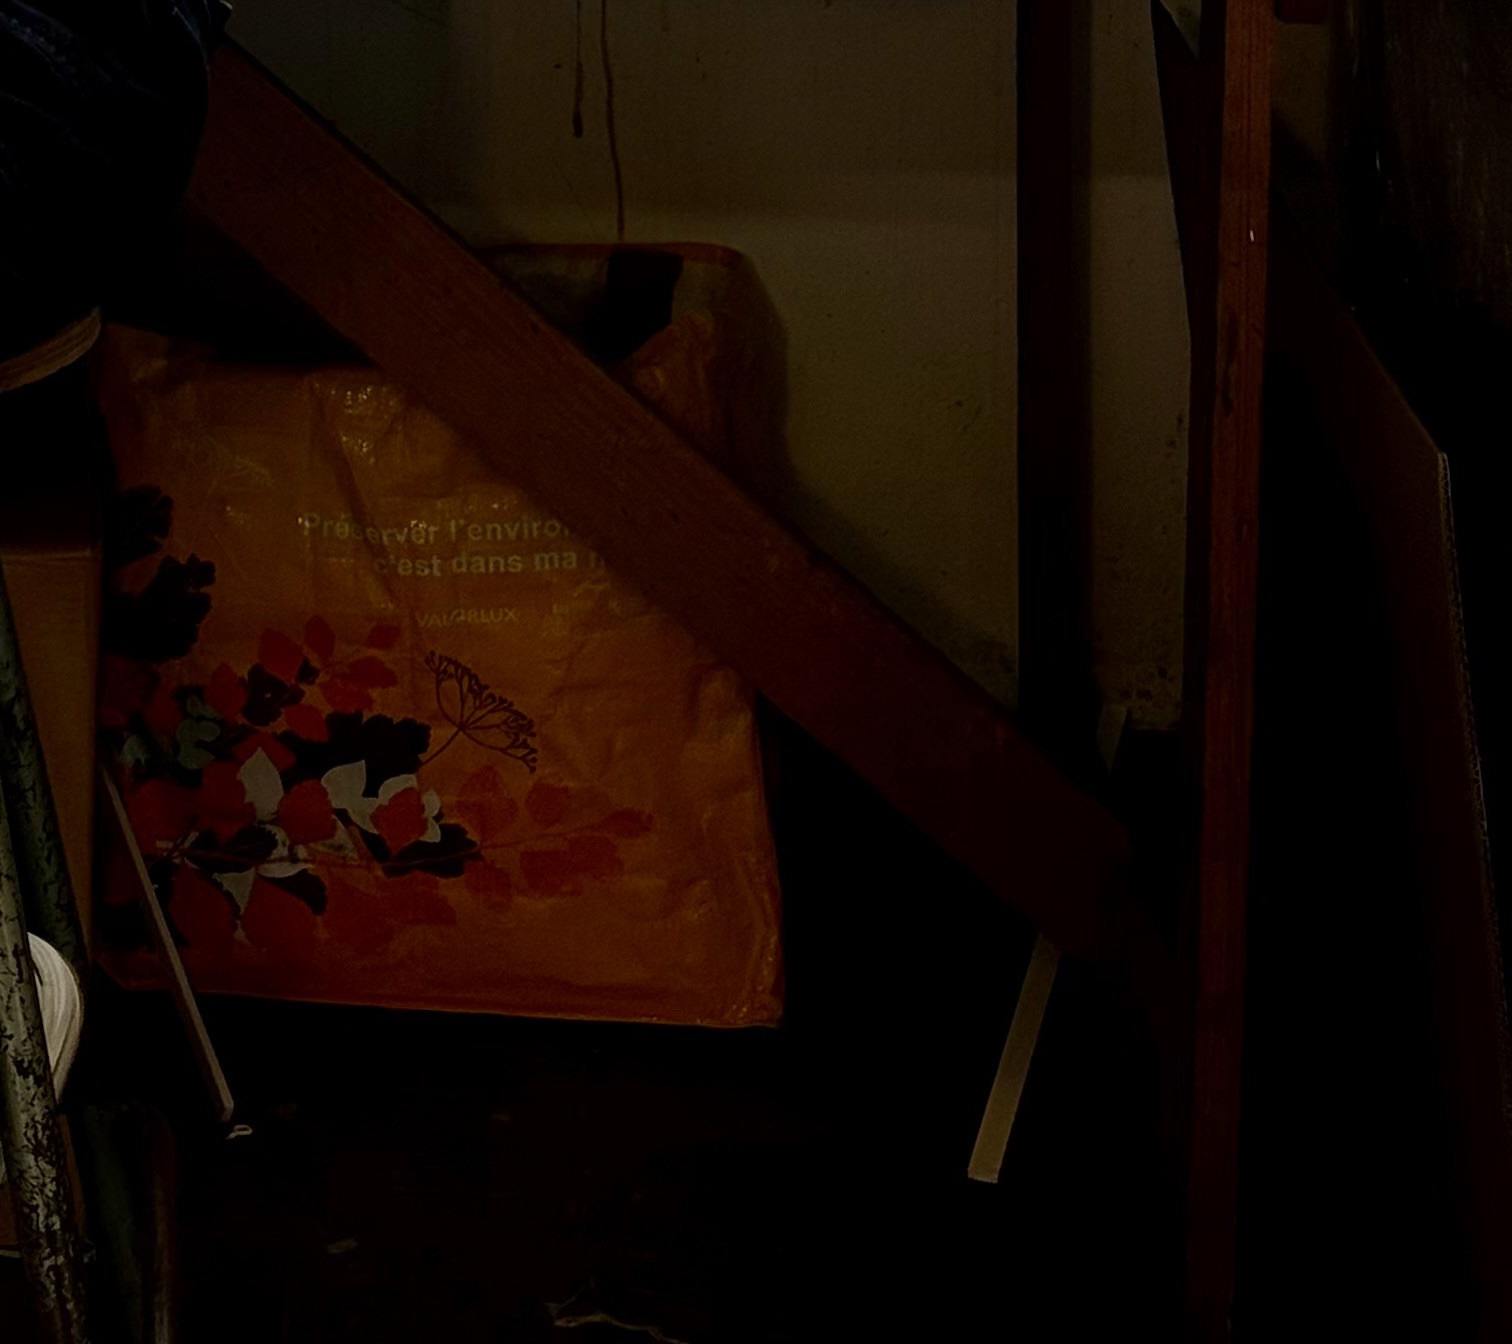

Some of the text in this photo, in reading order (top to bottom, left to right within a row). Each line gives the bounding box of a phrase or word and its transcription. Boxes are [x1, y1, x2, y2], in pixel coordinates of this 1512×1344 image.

[304, 512, 438, 545] Préserver
[375, 554, 442, 577] c'est
[451, 551, 523, 574] dans
[533, 550, 578, 571] ma
